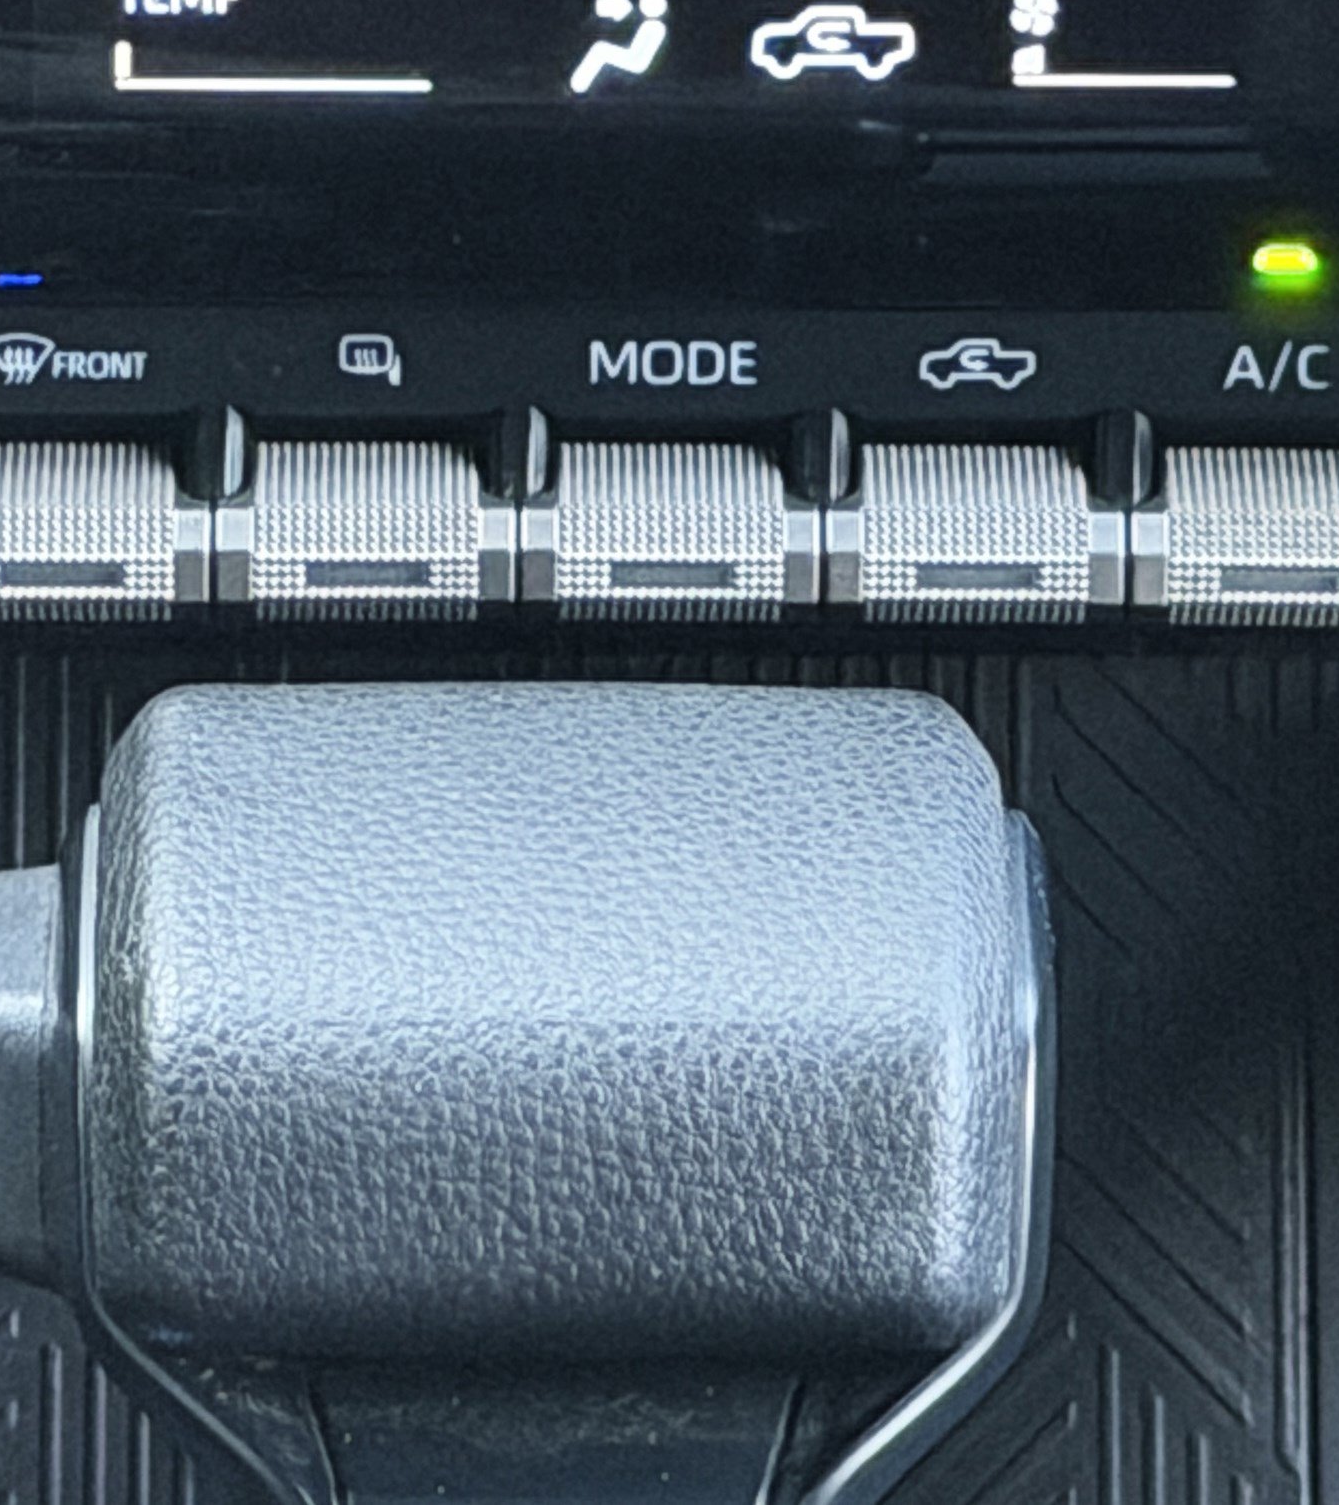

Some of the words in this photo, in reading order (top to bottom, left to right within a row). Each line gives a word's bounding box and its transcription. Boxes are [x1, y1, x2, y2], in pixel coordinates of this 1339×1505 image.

[50, 350, 148, 381] FRONT
[589, 340, 757, 386] MODE
[1223, 341, 1329, 392] A/C
